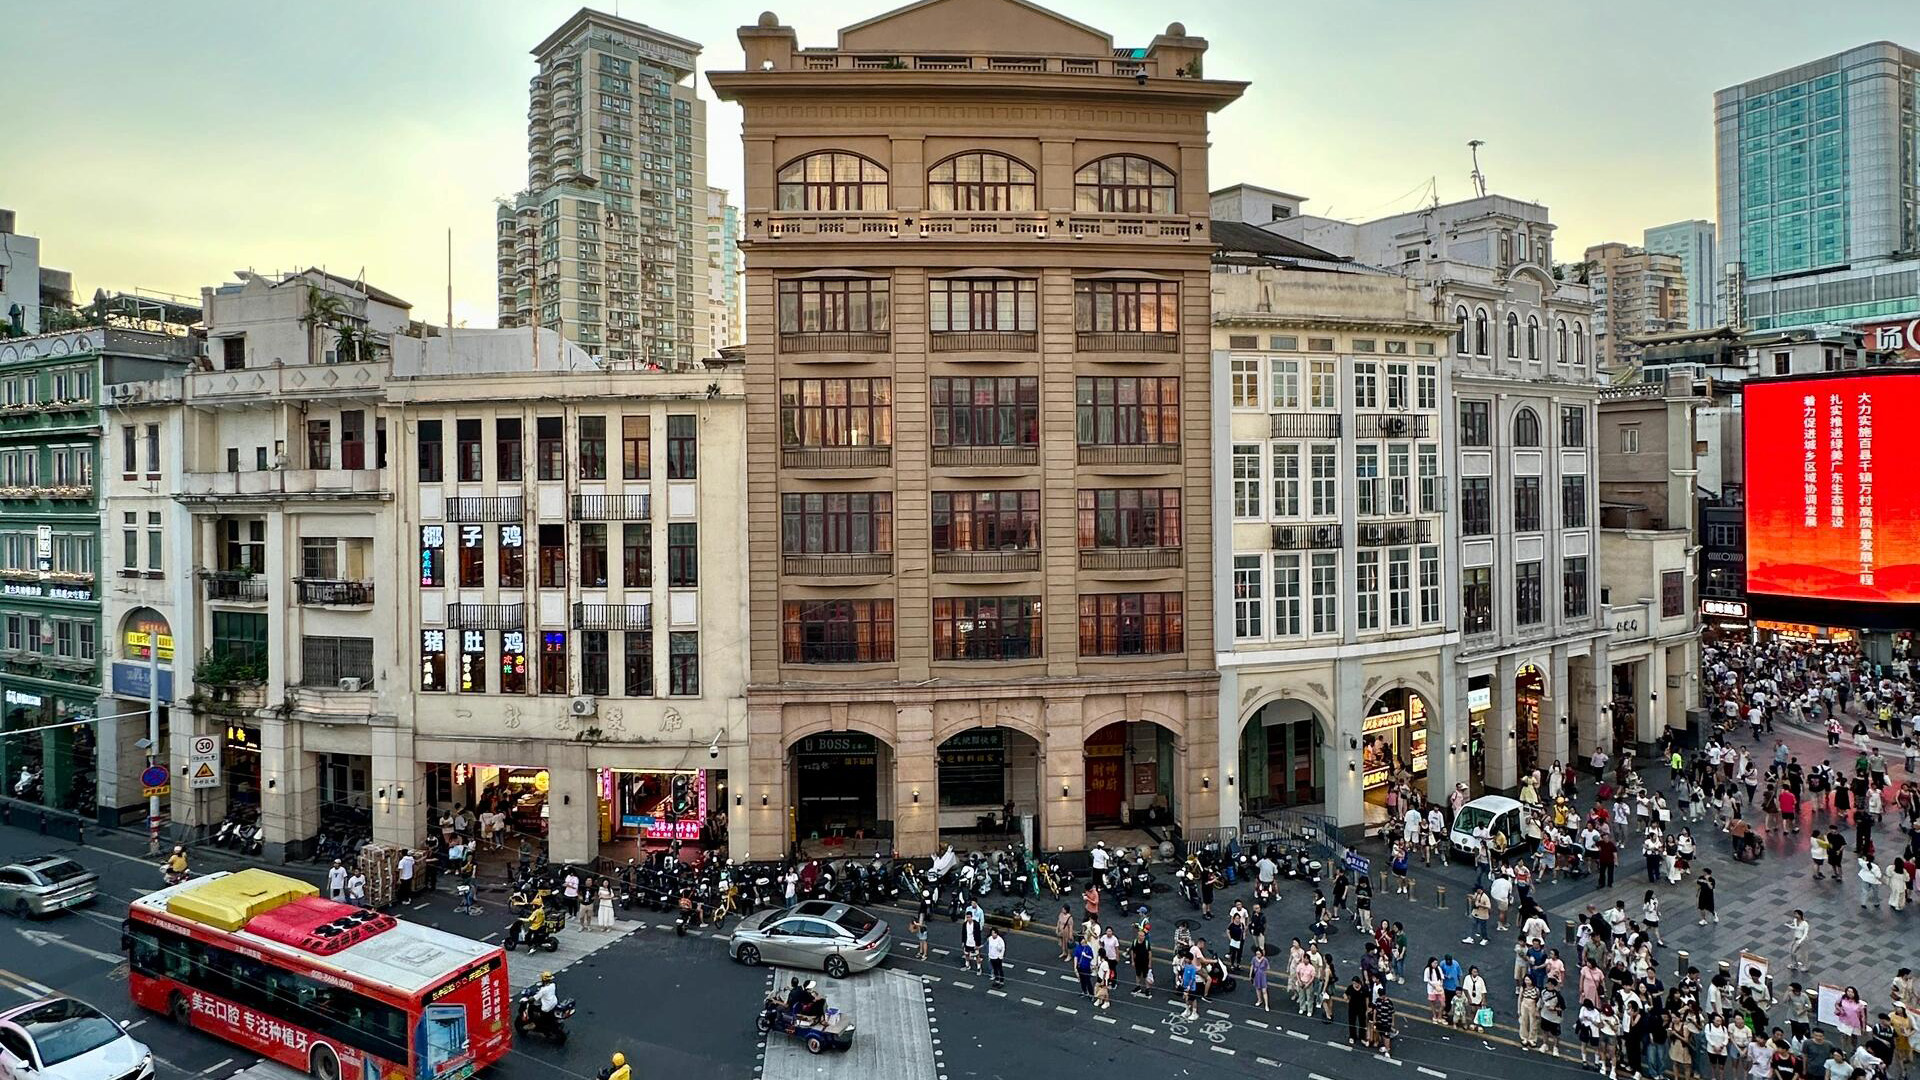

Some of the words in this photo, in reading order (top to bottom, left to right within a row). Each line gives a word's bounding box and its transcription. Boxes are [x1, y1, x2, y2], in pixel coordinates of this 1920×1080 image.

[1876, 326, 1903, 350] 场
[1803, 395, 1817, 528] 着力促进城乡区域协调发展
[1830, 394, 1844, 528] 扎实推进绿美广东生态建设
[1857, 393, 1874, 586] 大力实施百县千镇万村高质量发展工程
[423, 525, 522, 547] 椰子鸡
[424, 630, 524, 653] 猪肚鸡
[199, 741, 211, 750] 30
[819, 738, 850, 750] BOSS
[481, 975, 492, 1021] 美云口腔
[191, 990, 240, 1027] 美云口腔
[243, 1010, 309, 1051] 专注种植牙
